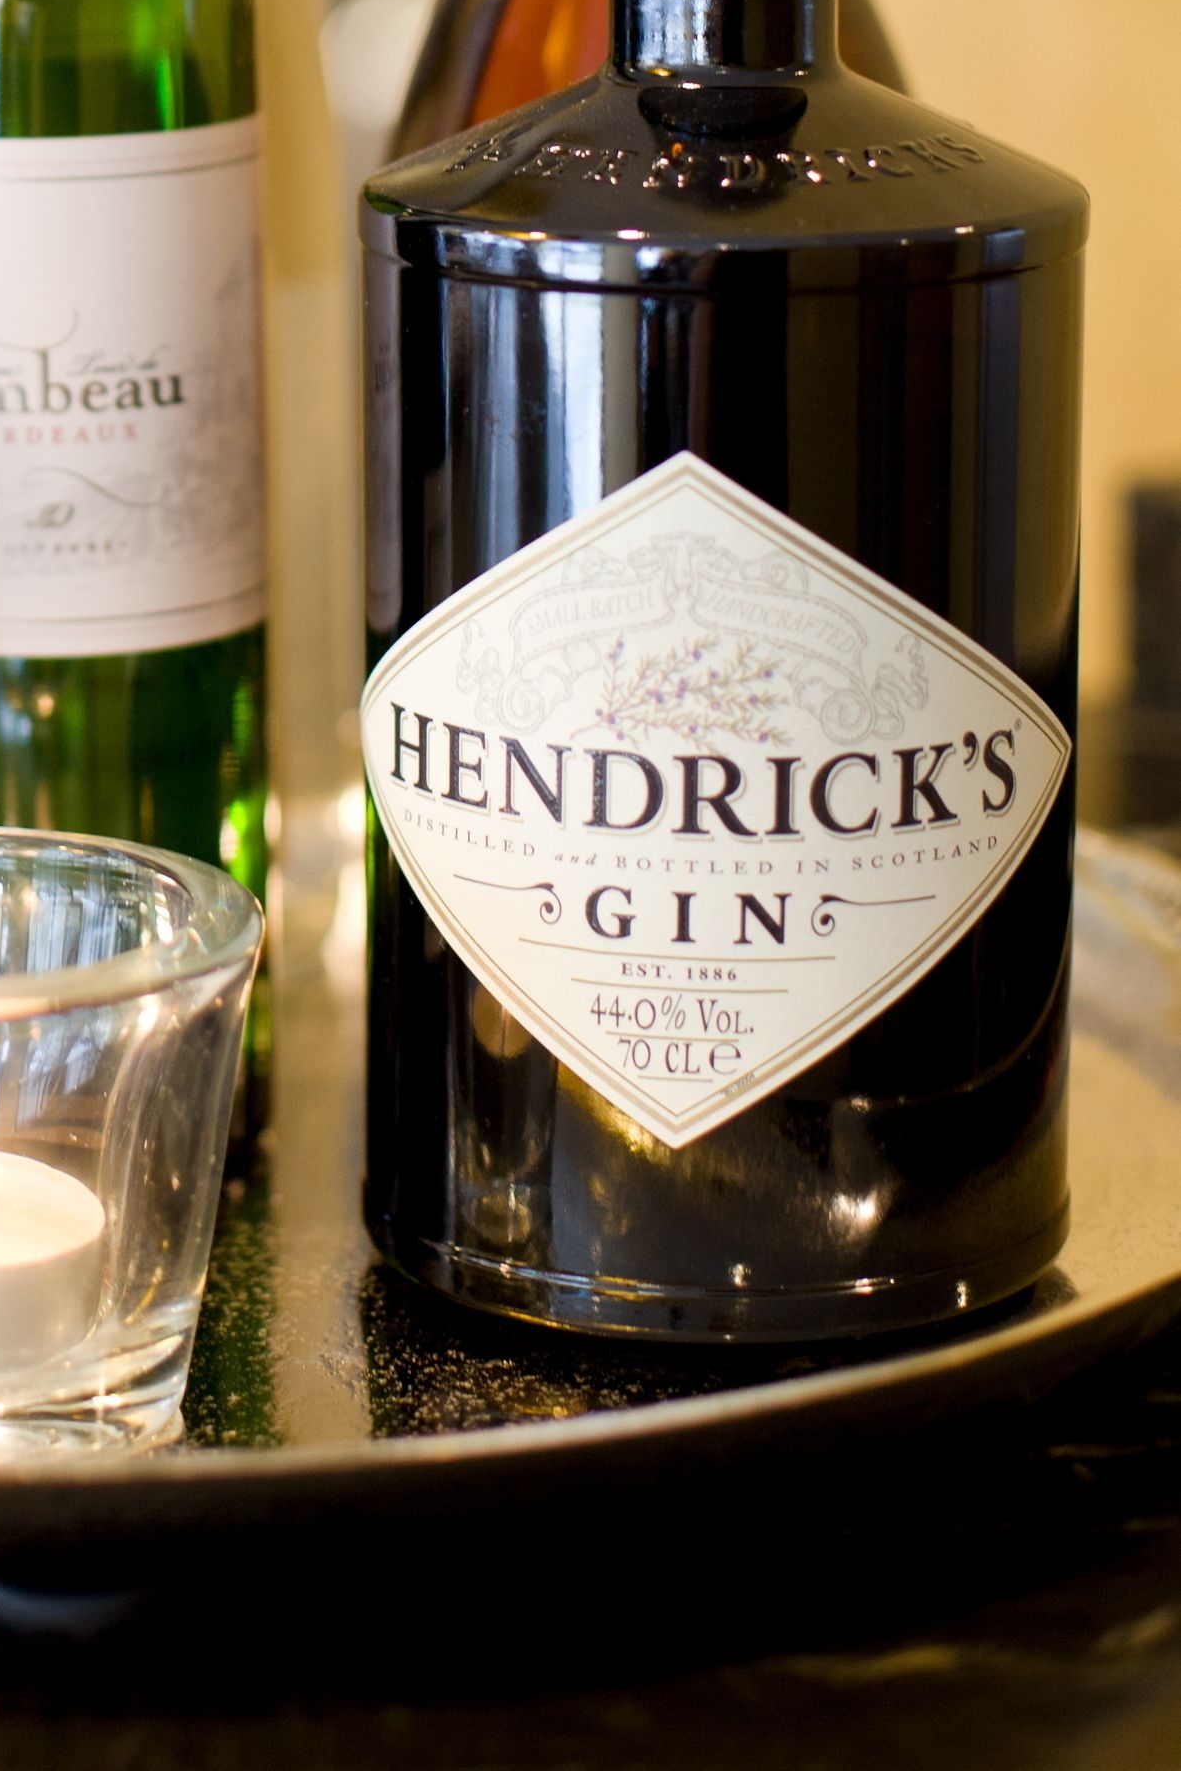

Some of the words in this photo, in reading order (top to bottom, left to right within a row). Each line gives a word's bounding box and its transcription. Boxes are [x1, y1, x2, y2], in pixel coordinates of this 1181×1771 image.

[525, 597, 582, 635] SMALL
[591, 586, 653, 619] BATCH
[700, 589, 856, 653] HANDCRAFTED
[390, 700, 1017, 839] HENDRICK'S
[404, 808, 536, 858] DISTILLED
[554, 852, 597, 867] and
[615, 855, 774, 875] BOTTLED
[796, 858, 831, 874] IN
[851, 834, 999, 871] SCOTLAND
[584, 884, 793, 945] GIN
[621, 962, 672, 980] EST.
[686, 966, 738, 982] 1886
[589, 993, 687, 1031] 44.0%
[617, 1038, 652, 1071] 70
